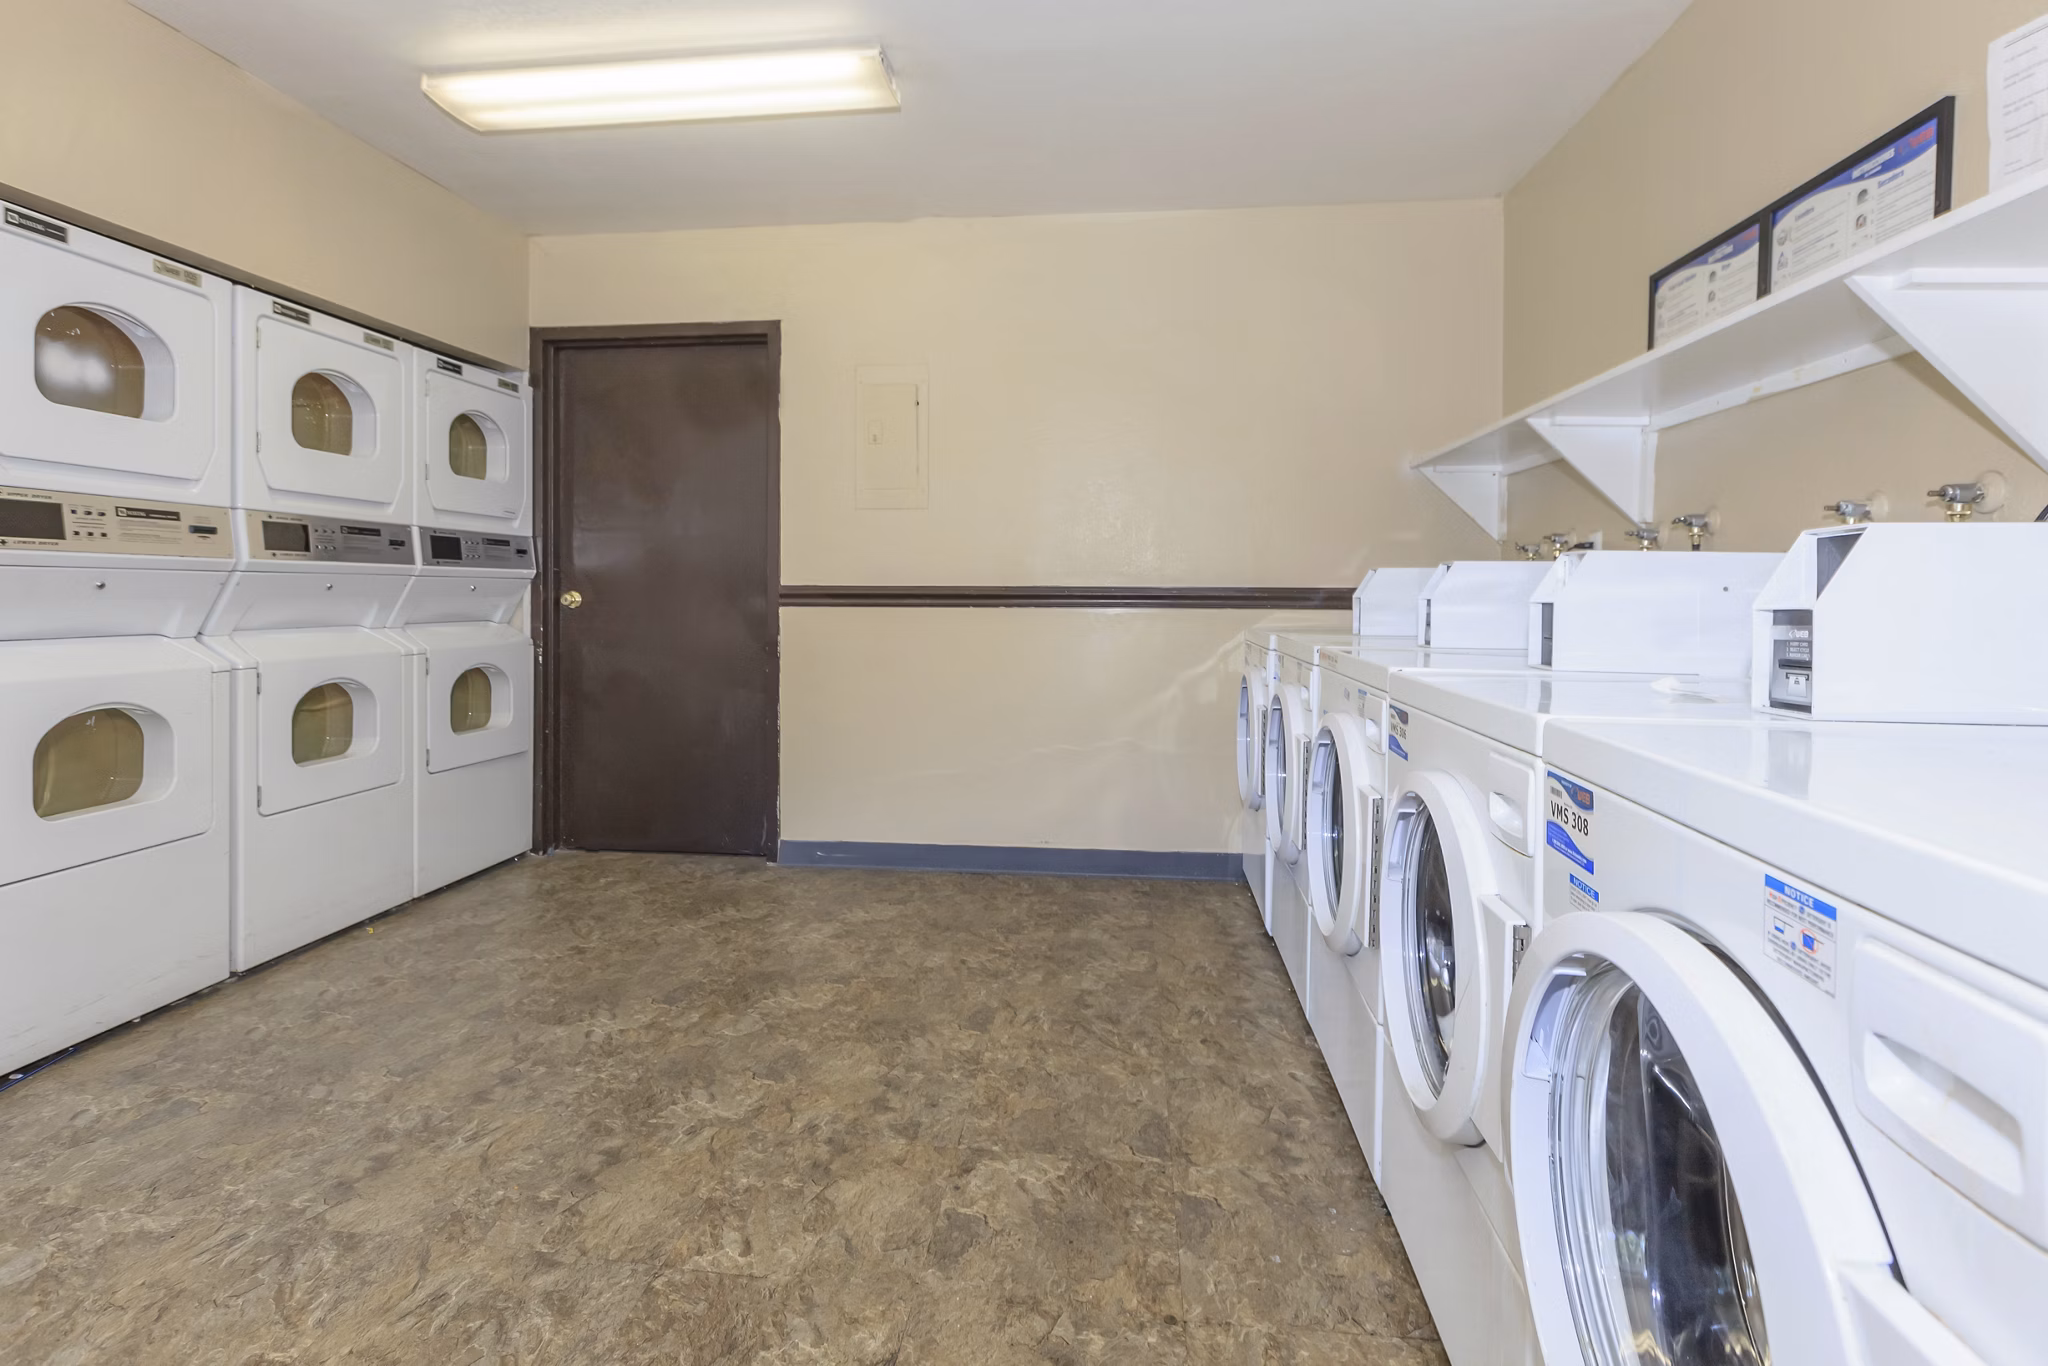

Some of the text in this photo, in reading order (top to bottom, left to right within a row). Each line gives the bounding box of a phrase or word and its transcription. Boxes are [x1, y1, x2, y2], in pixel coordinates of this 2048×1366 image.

[1550, 800, 1589, 836] VMS 308
[1573, 876, 1596, 900] NOTICE
[1784, 885, 1814, 908] NOTICE
